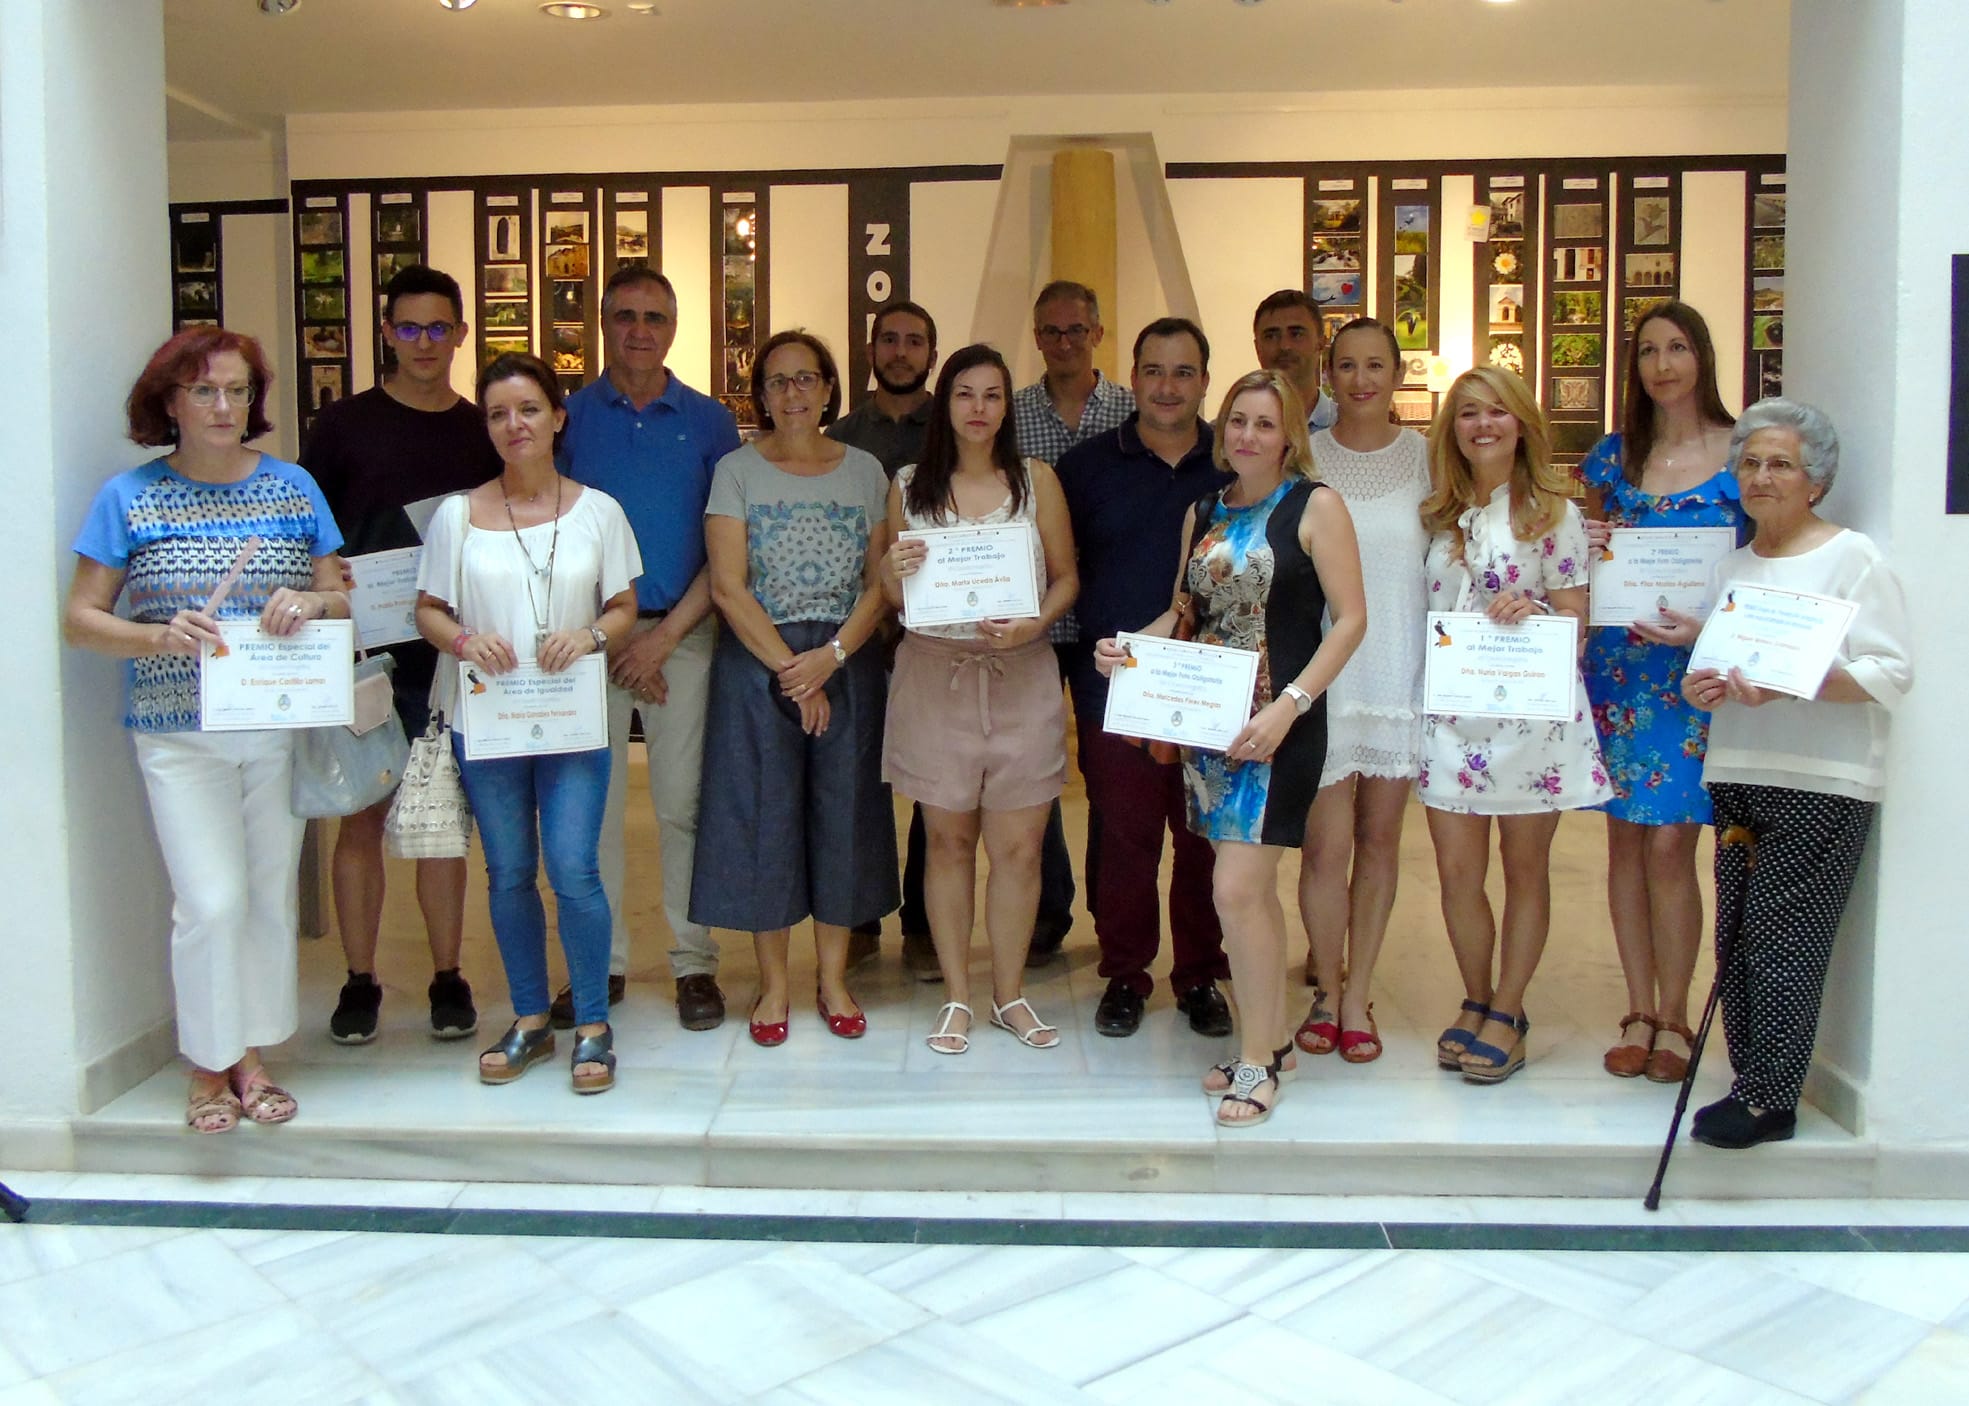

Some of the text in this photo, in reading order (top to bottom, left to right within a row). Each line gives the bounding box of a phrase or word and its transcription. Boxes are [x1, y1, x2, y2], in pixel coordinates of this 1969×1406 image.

[961, 544, 994, 553] PREMIO
[947, 556, 971, 564] Mejor
[974, 552, 1006, 561] Trabajo
[1494, 635, 1531, 644] PREMIO
[240, 643, 331, 652] PREMIO Especial del
[1478, 644, 1505, 654] Mejor
[1508, 646, 1544, 655] Trabajo
[290, 653, 322, 662] Cultura
[528, 678, 561, 686] Especial
[537, 686, 573, 696] Igualdad
